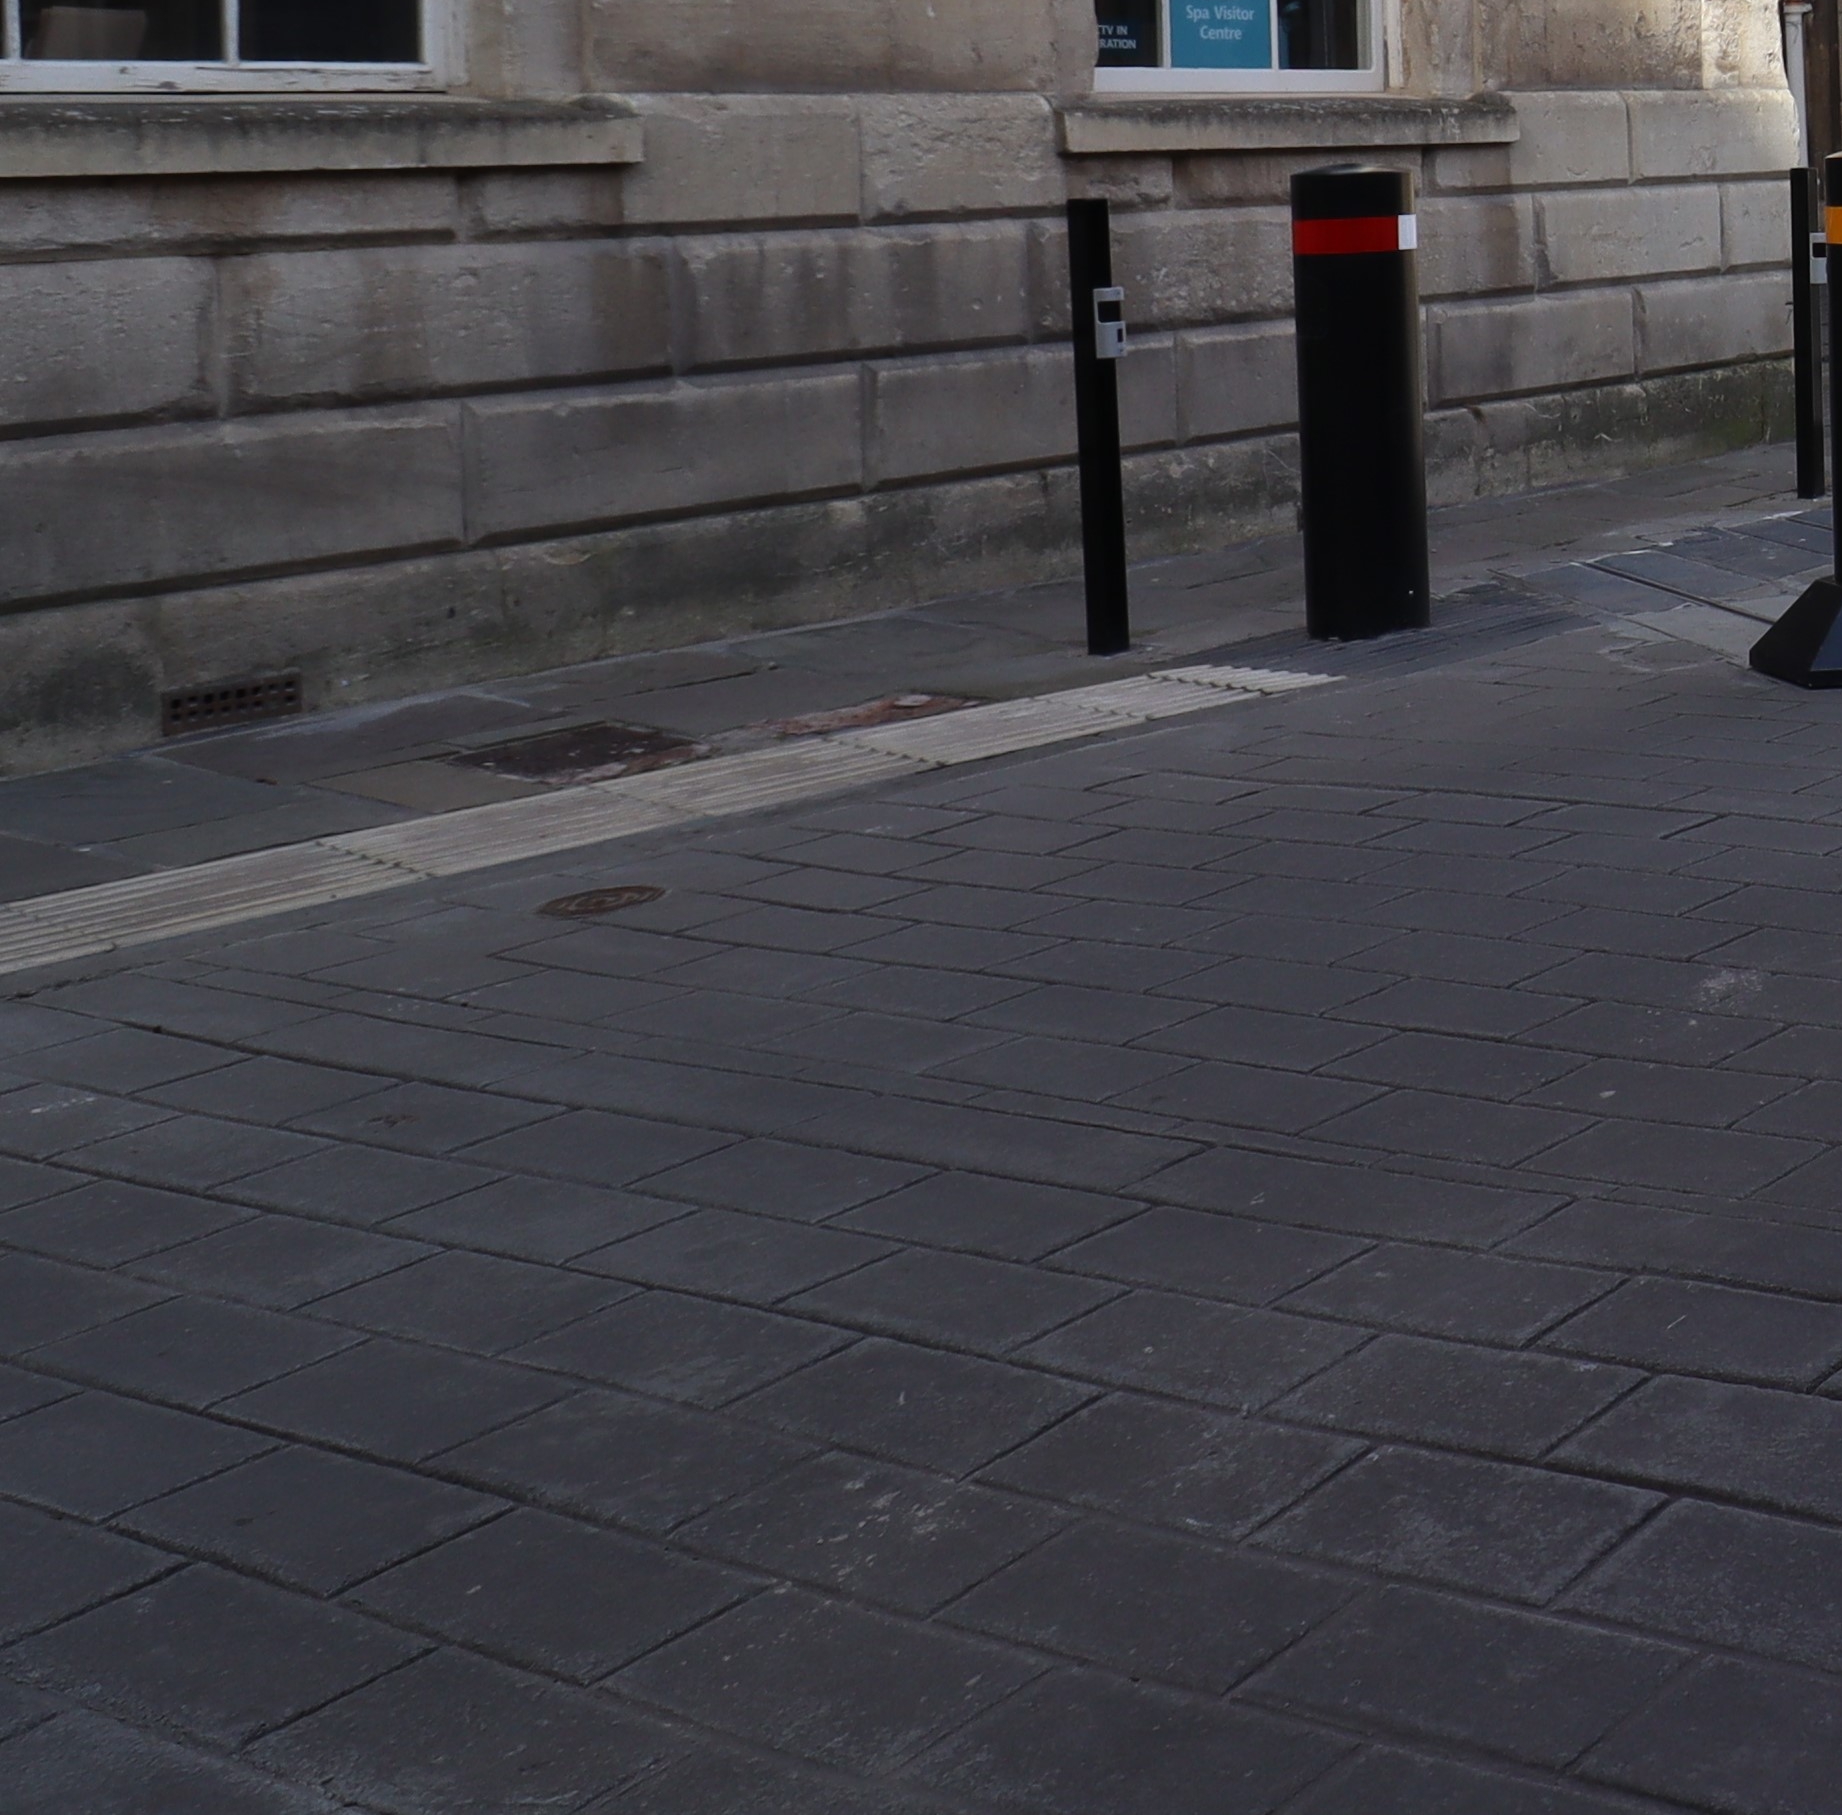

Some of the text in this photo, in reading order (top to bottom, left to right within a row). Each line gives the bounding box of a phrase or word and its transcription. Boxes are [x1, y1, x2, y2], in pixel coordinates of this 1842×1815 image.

[1186, 4, 1255, 22] Spa Visitor
[1116, 25, 1128, 35] IN
[1199, 25, 1242, 40] Centre
